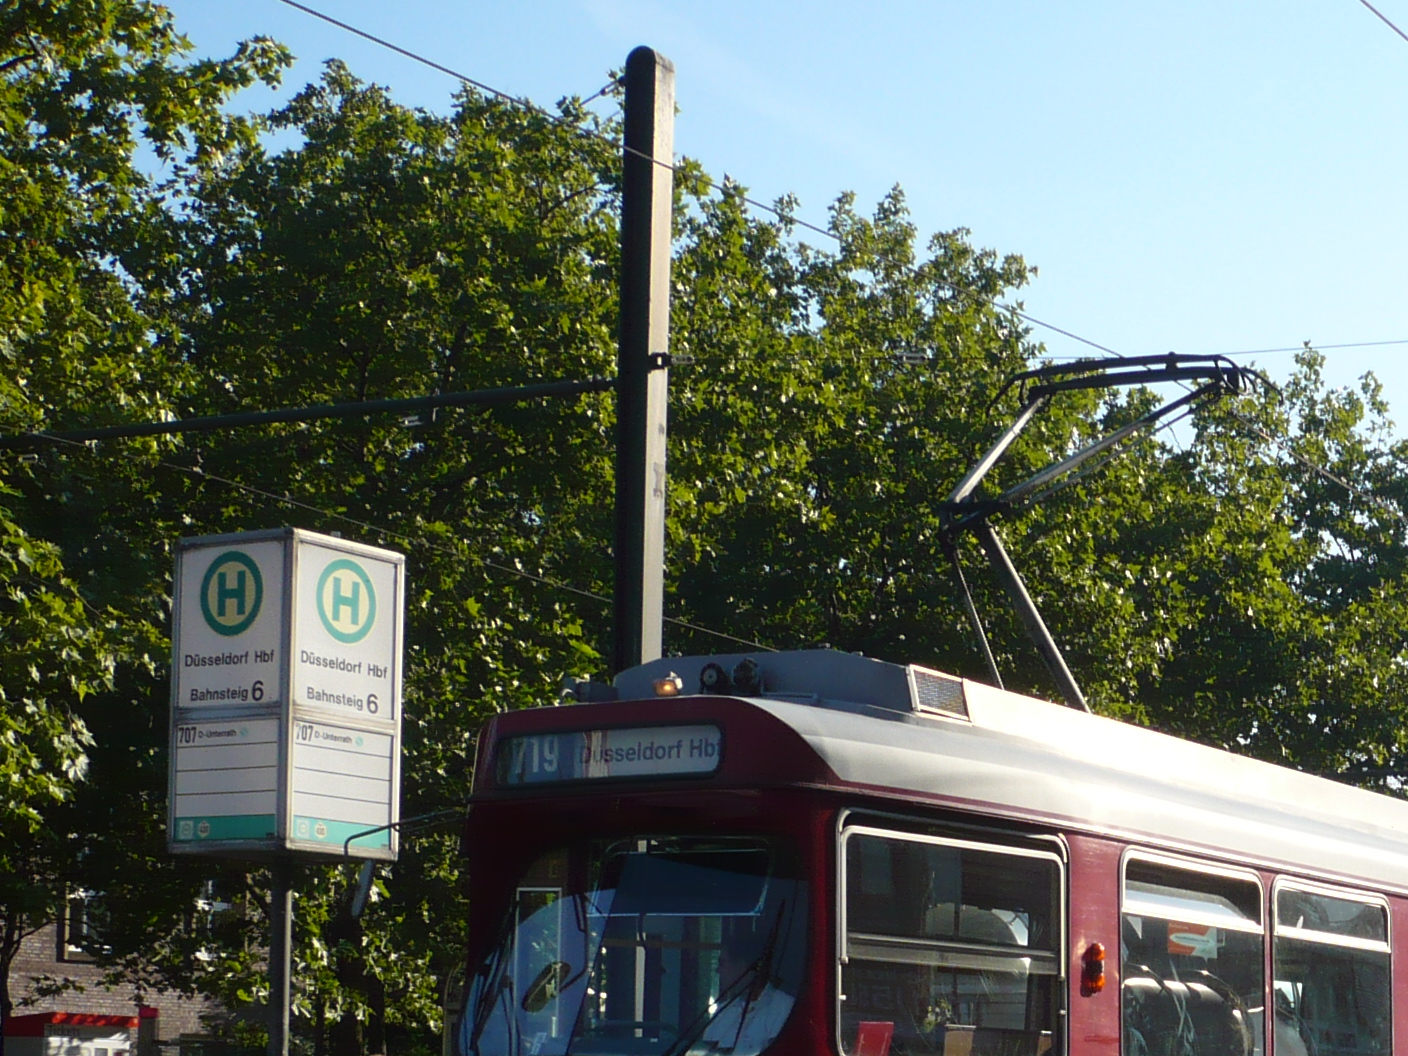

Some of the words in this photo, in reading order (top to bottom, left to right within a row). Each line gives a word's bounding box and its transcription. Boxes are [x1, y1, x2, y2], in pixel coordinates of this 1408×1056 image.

[217, 570, 246, 618] H
[332, 576, 361, 626] H
[184, 650, 250, 668] Düsseldorf
[254, 648, 275, 664] Hbf
[300, 650, 362, 674] Düsseldorf
[367, 663, 388, 680] Hbf
[190, 687, 248, 702] Bahnsteig
[251, 680, 264, 701] 6
[306, 686, 364, 711] Bahnsteig
[366, 693, 379, 715] 6
[179, 726, 197, 744] 707
[296, 722, 314, 742] 707
